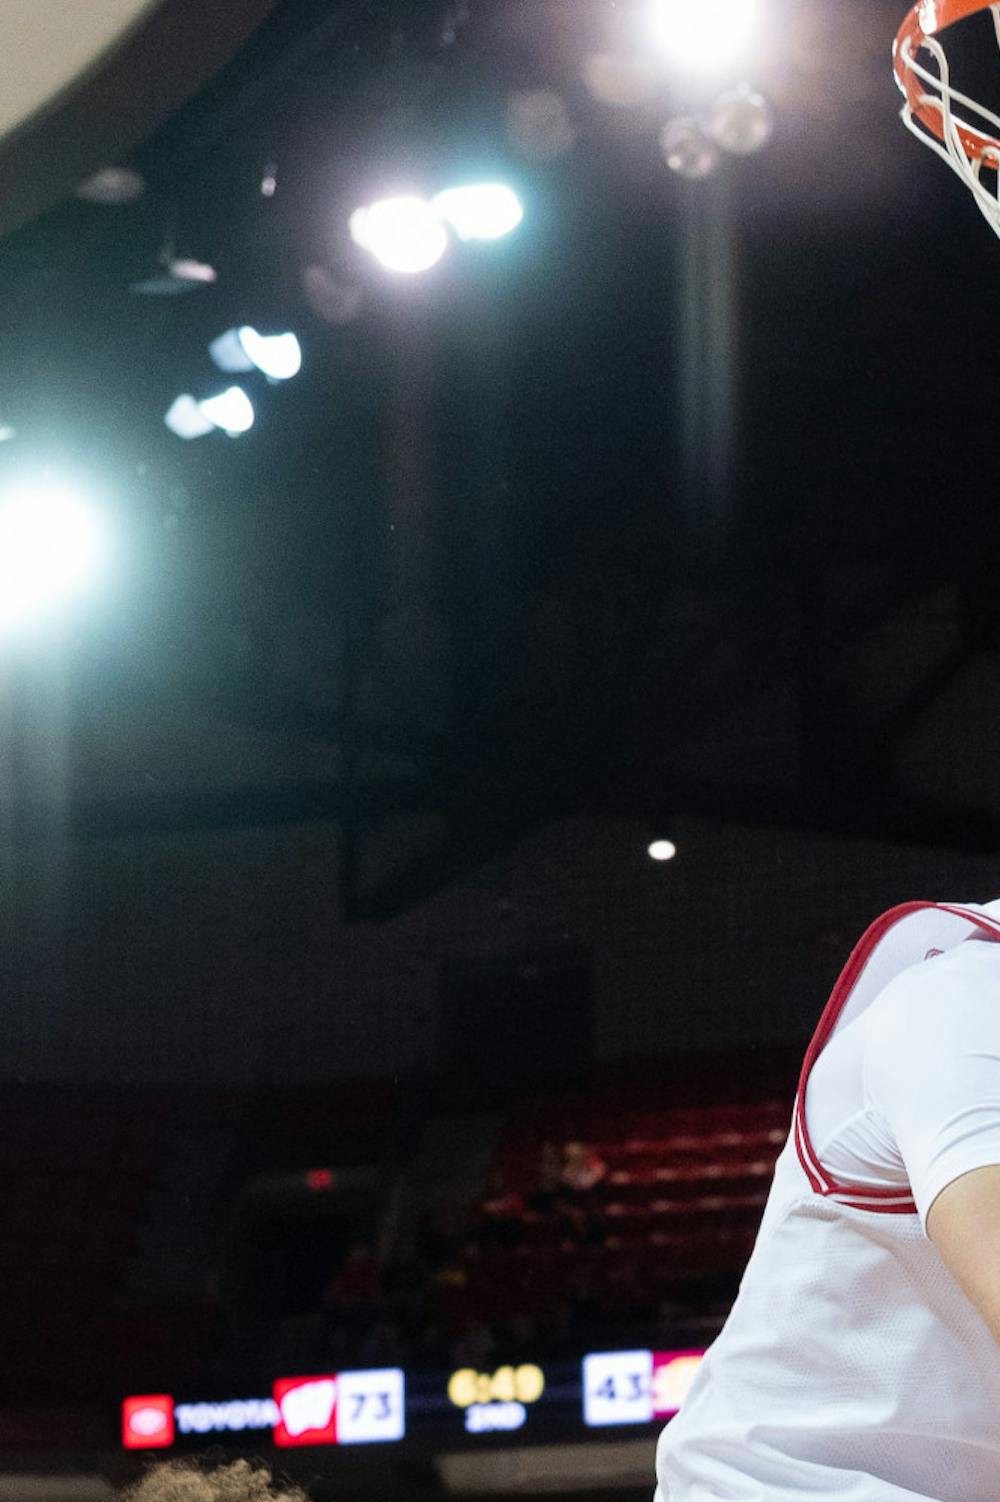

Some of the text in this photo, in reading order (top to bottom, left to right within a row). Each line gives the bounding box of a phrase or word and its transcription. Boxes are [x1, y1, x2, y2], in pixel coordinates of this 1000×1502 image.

[597, 1373, 644, 1401] 43
[174, 1399, 281, 1433] TOYOTA
[350, 1392, 391, 1421] 73
